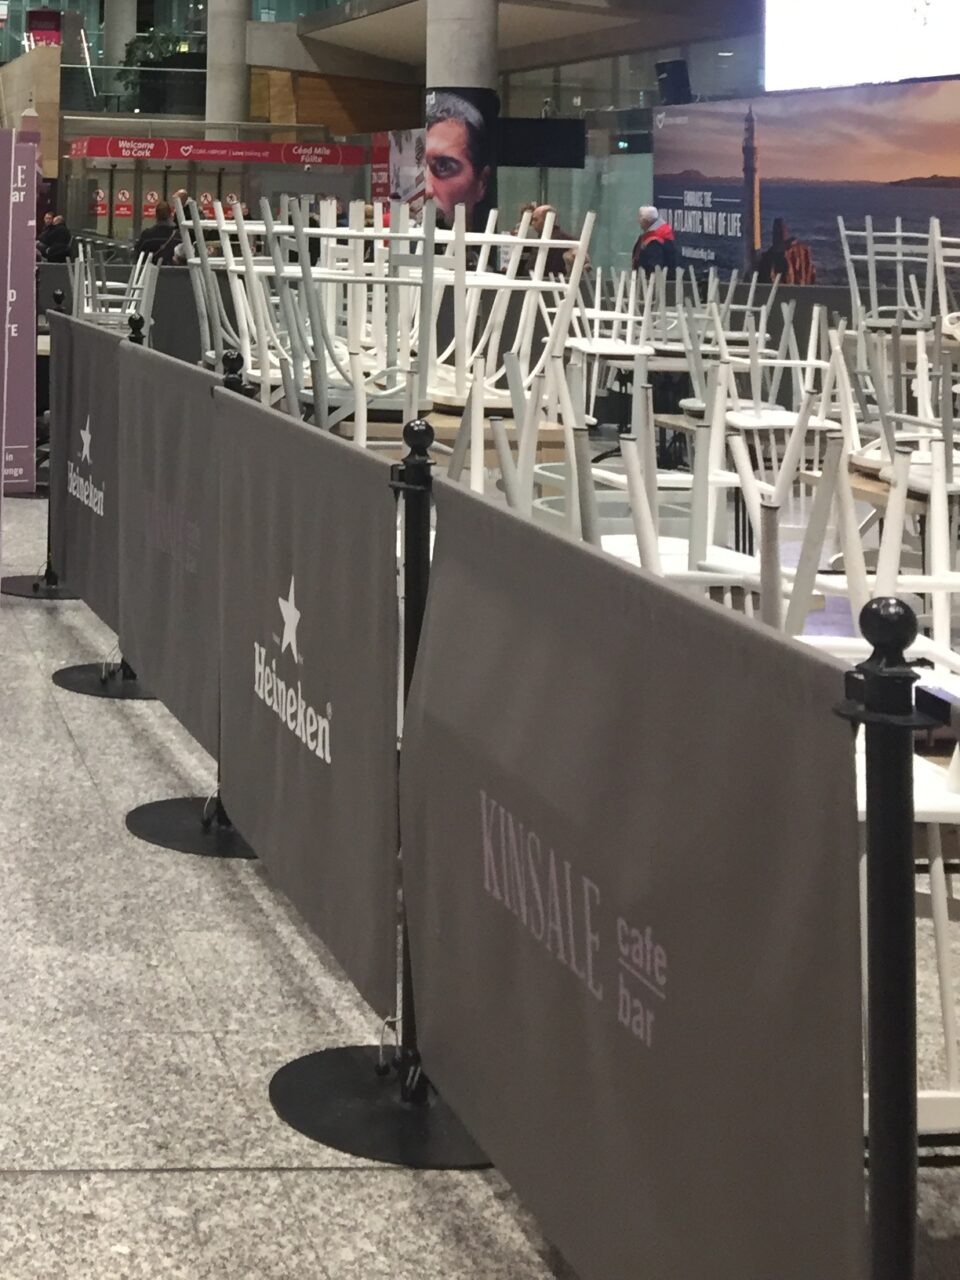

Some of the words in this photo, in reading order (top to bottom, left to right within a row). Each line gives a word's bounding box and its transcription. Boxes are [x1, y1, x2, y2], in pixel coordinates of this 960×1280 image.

[118, 139, 155, 150] Welcome
[122, 148, 130, 157] to
[131, 149, 151, 157] Cork
[11, 191, 26, 203] ar
[727, 213, 742, 237] LIFE
[3, 467, 24, 477] unge
[67, 460, 104, 517] Heineken
[253, 640, 332, 765] Heineken
[480, 788, 604, 1002] KINSALE
[616, 915, 668, 987] cafe
[617, 971, 656, 1048] bar
